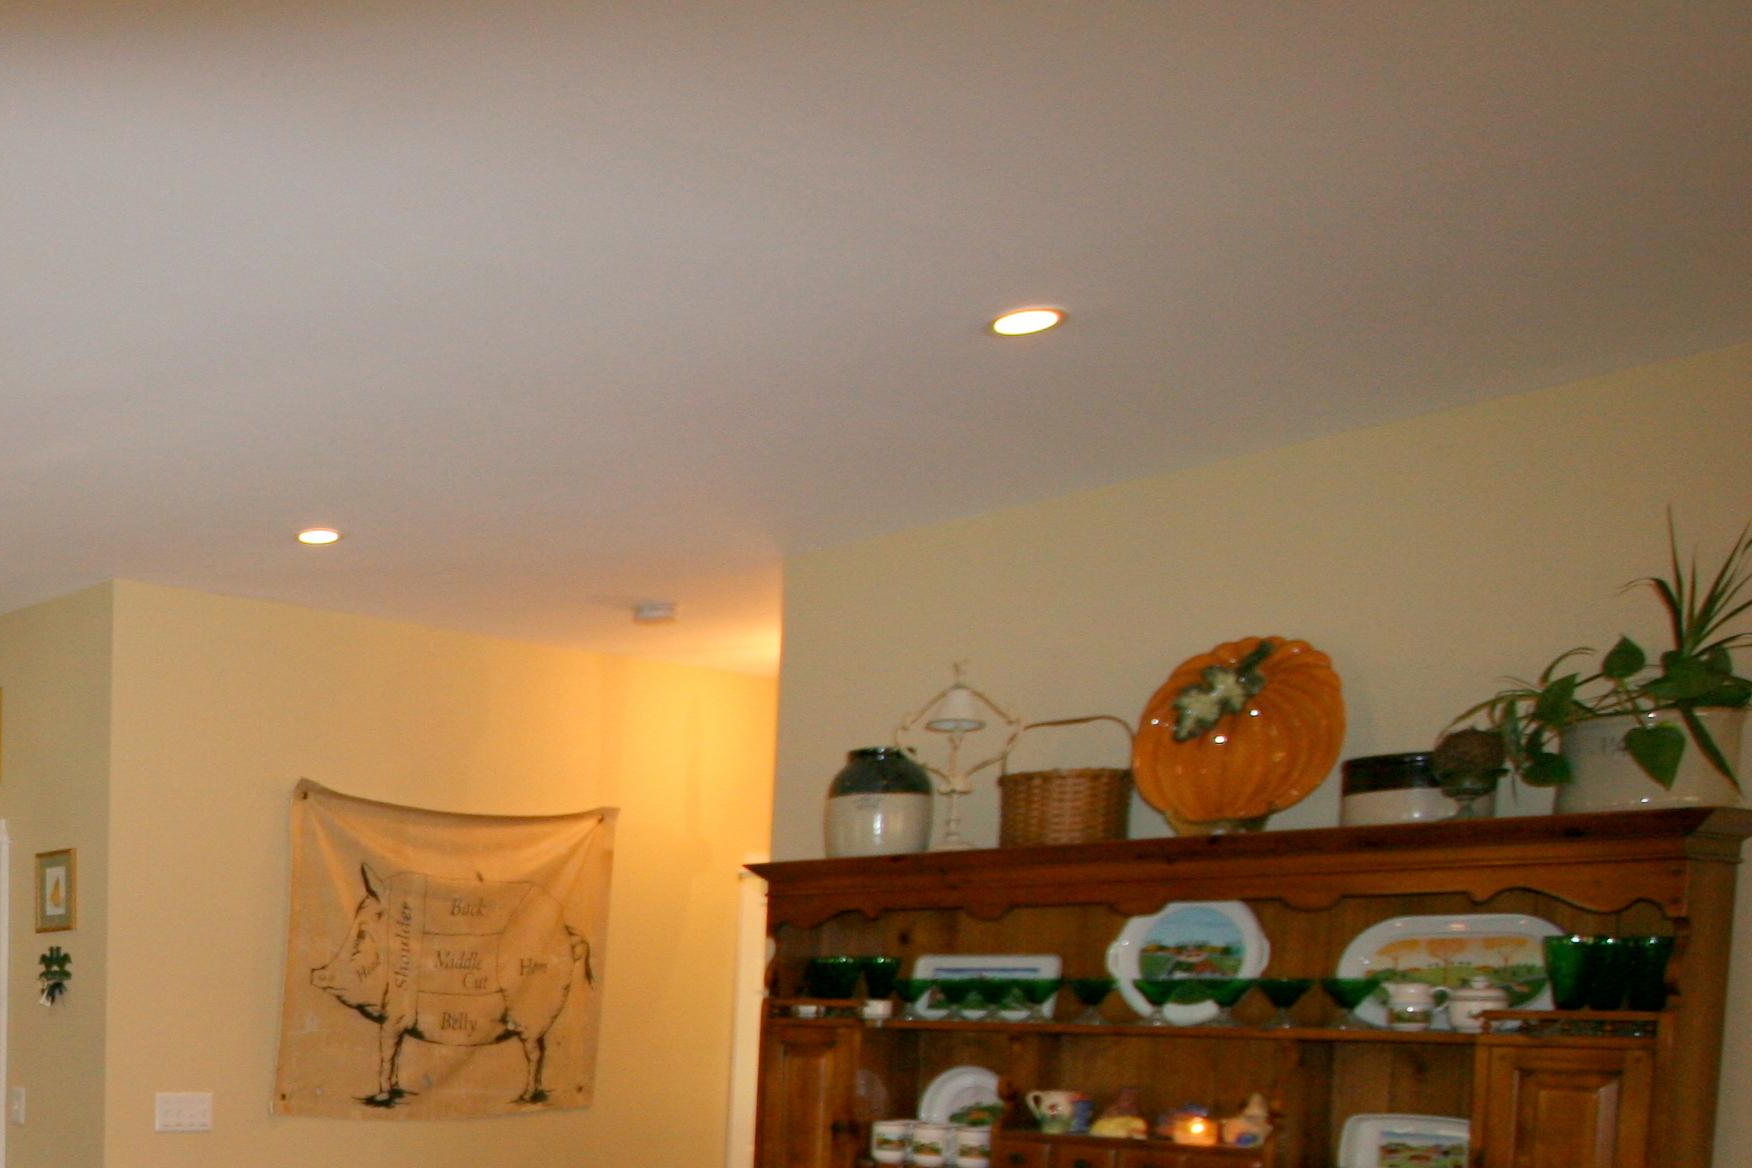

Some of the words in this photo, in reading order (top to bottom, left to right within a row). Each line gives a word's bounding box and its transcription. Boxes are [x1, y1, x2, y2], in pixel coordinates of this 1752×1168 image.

[450, 895, 487, 917] Back
[393, 901, 412, 991] Shoulder
[434, 949, 482, 971] Middle
[462, 972, 489, 991] Cut
[440, 1010, 478, 1037] Belly
